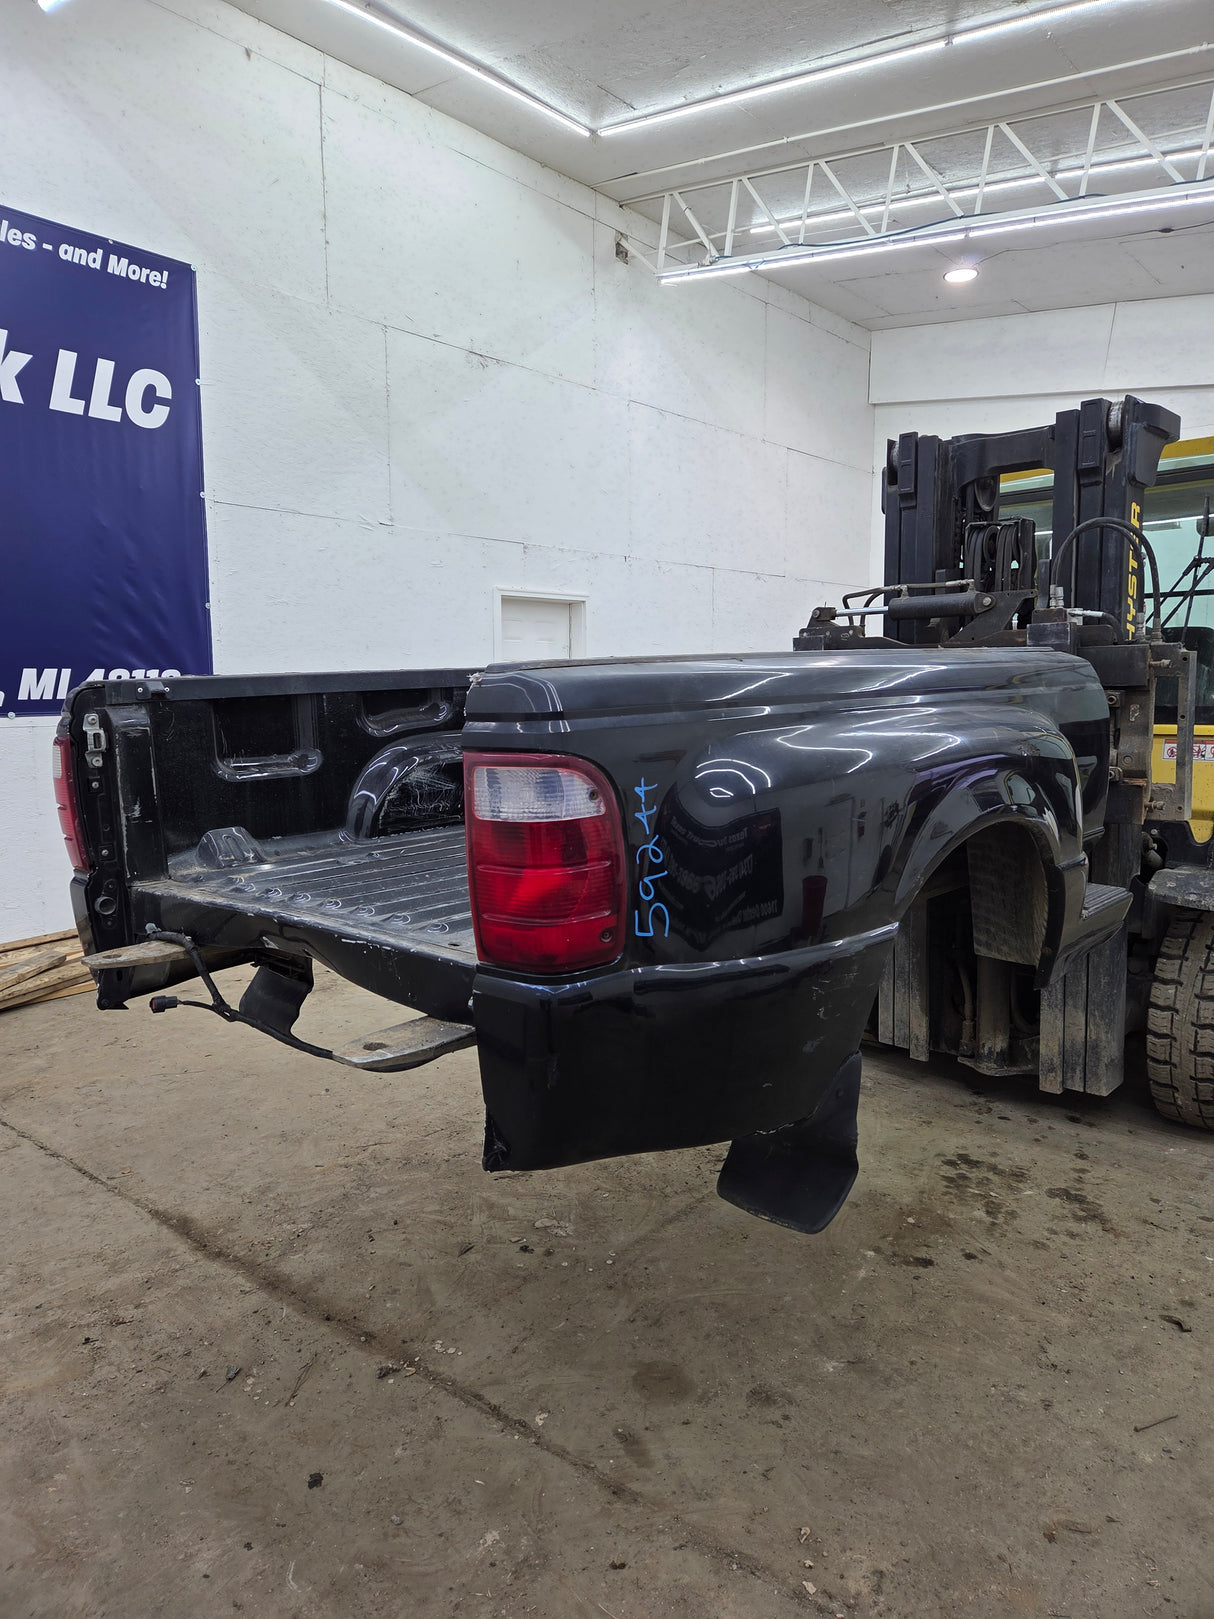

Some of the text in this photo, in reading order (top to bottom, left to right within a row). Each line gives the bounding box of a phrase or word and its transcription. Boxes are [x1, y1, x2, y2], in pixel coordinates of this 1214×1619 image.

[58, 243, 104, 270] and
[107, 254, 169, 289] More!
[49, 348, 172, 429] LLC
[17, 667, 72, 700] MI
